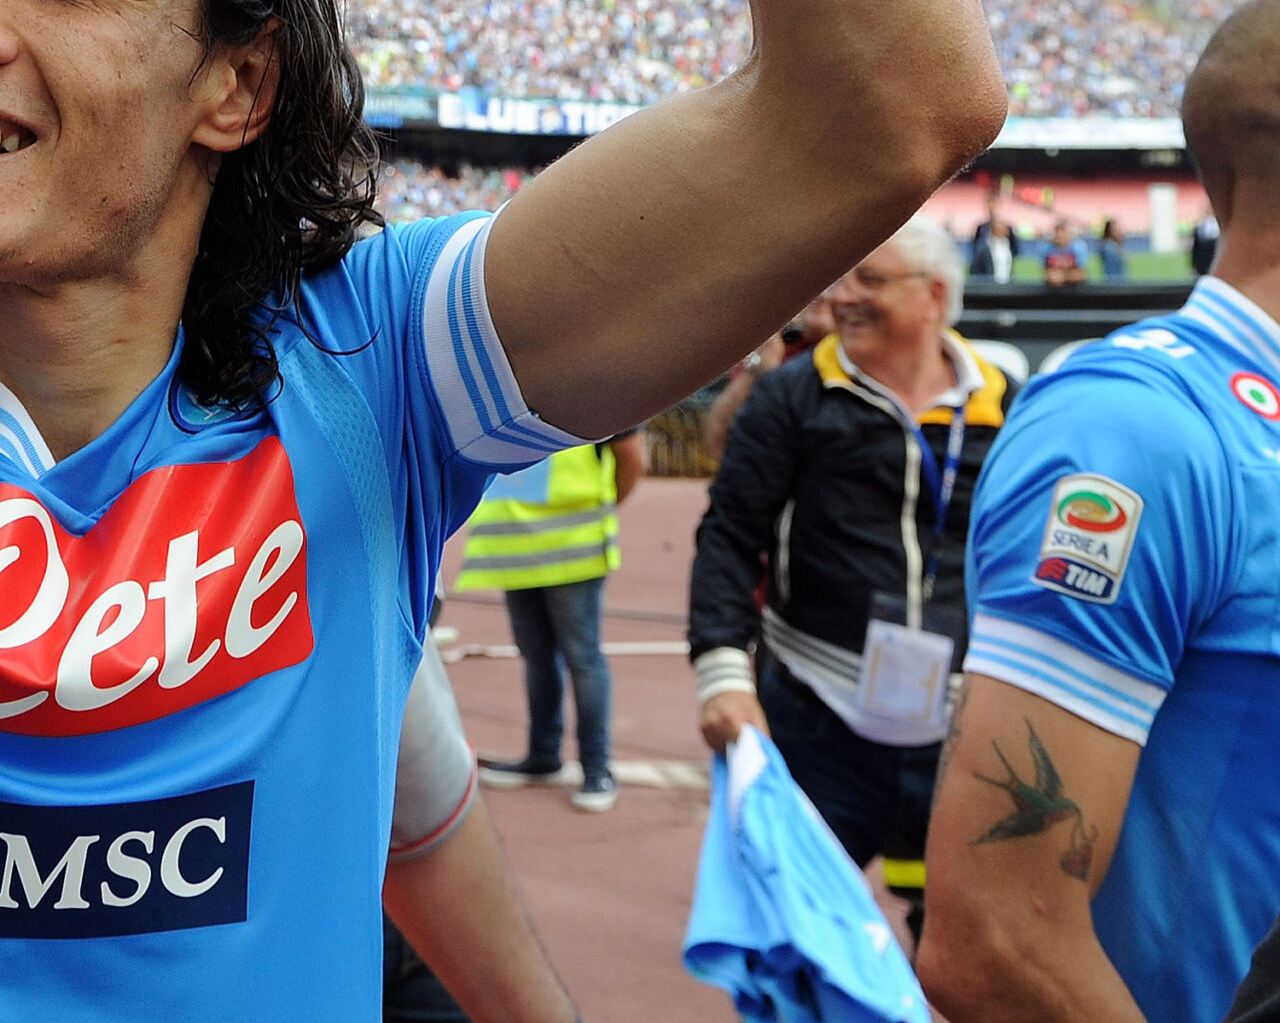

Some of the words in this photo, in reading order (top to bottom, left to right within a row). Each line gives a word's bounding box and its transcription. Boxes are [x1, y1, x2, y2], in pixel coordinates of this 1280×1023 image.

[1051, 529, 1095, 555] SERIE
[1096, 541, 1110, 561] A
[1065, 563, 1108, 597] TIM
